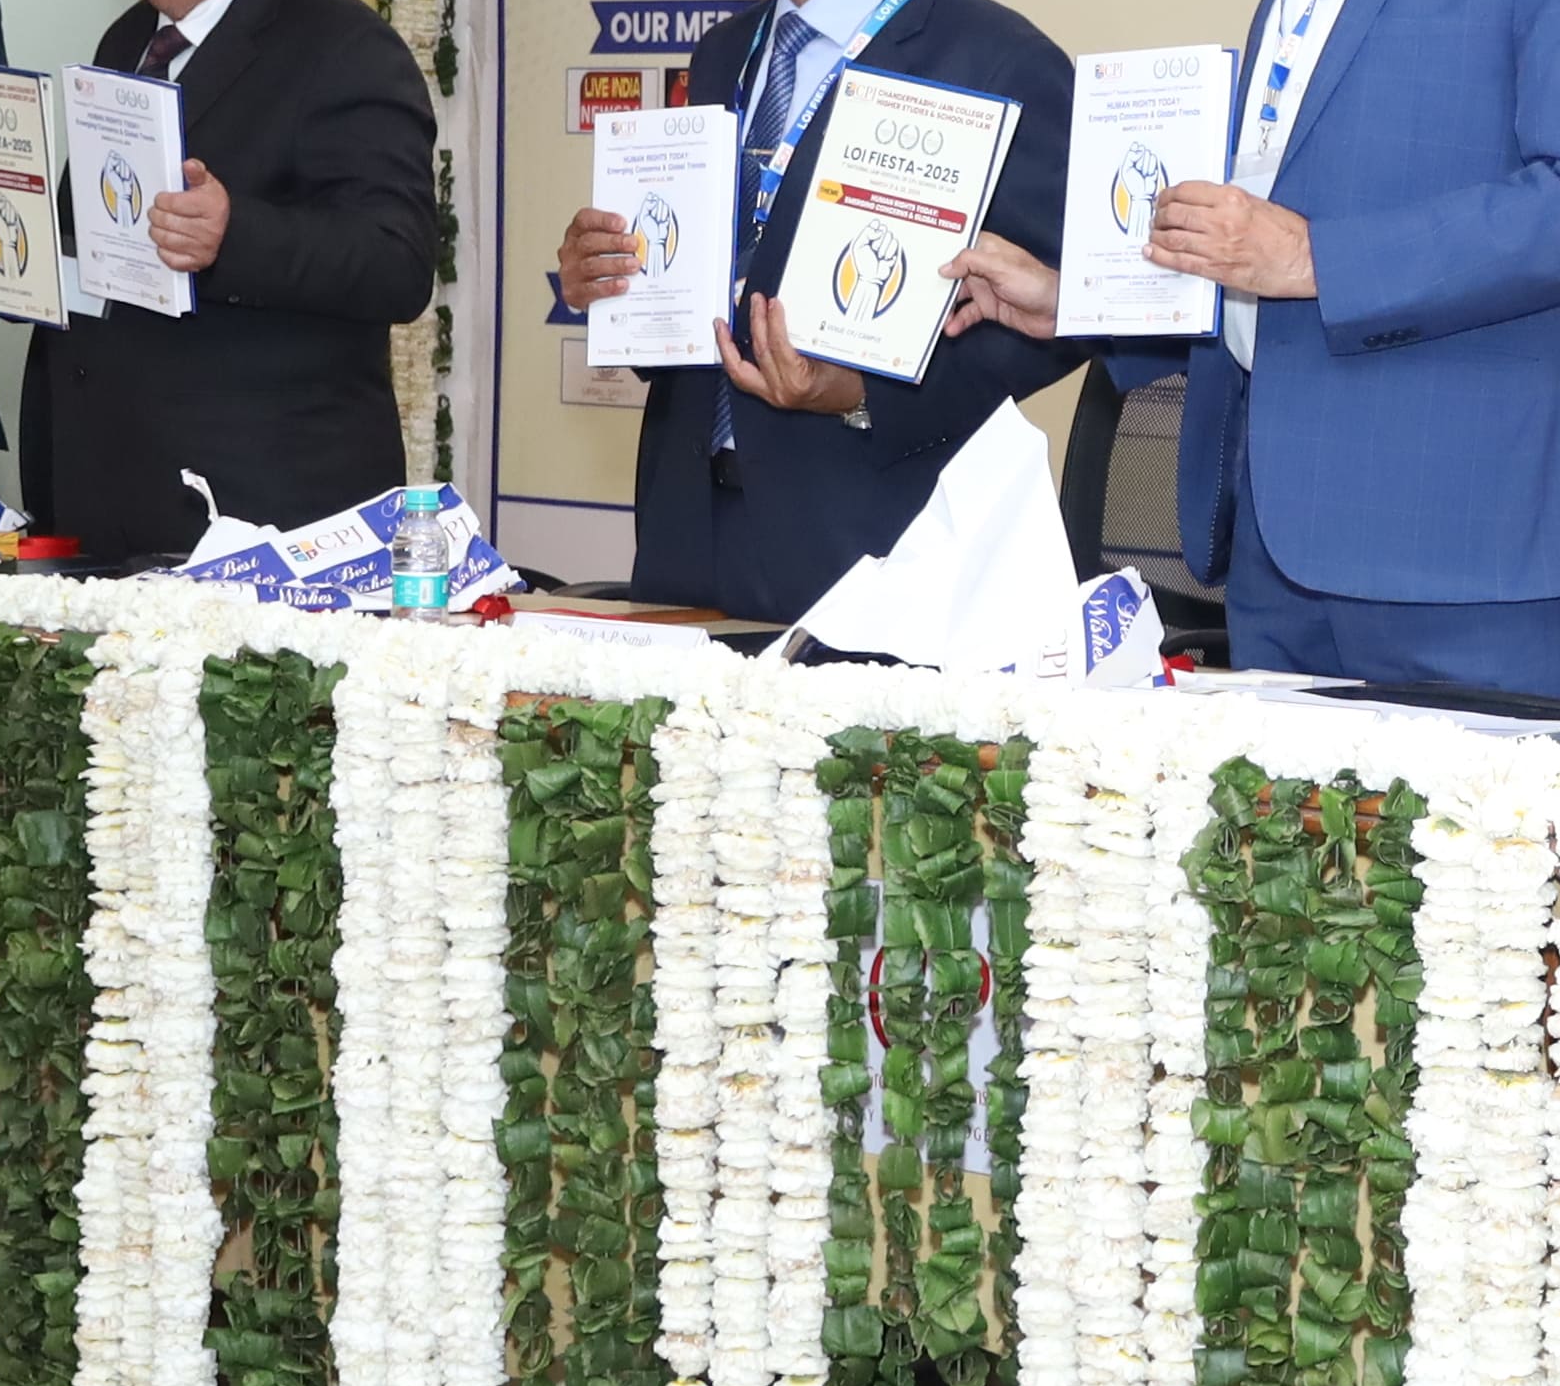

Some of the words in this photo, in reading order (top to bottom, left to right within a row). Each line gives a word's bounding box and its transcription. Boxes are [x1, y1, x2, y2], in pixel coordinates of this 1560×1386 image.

[875, 2, 894, 22] LOI
[610, 10, 670, 44] OUR
[583, 76, 610, 99] LIVE
[611, 75, 642, 99] INDIA
[796, 109, 817, 131] LOI
[843, 144, 867, 163] LOI
[868, 149, 961, 185] FIESTA-2025
[312, 523, 364, 552] CPJ
[269, 585, 338, 607] Wishes
[1087, 587, 1114, 664] Wishe
